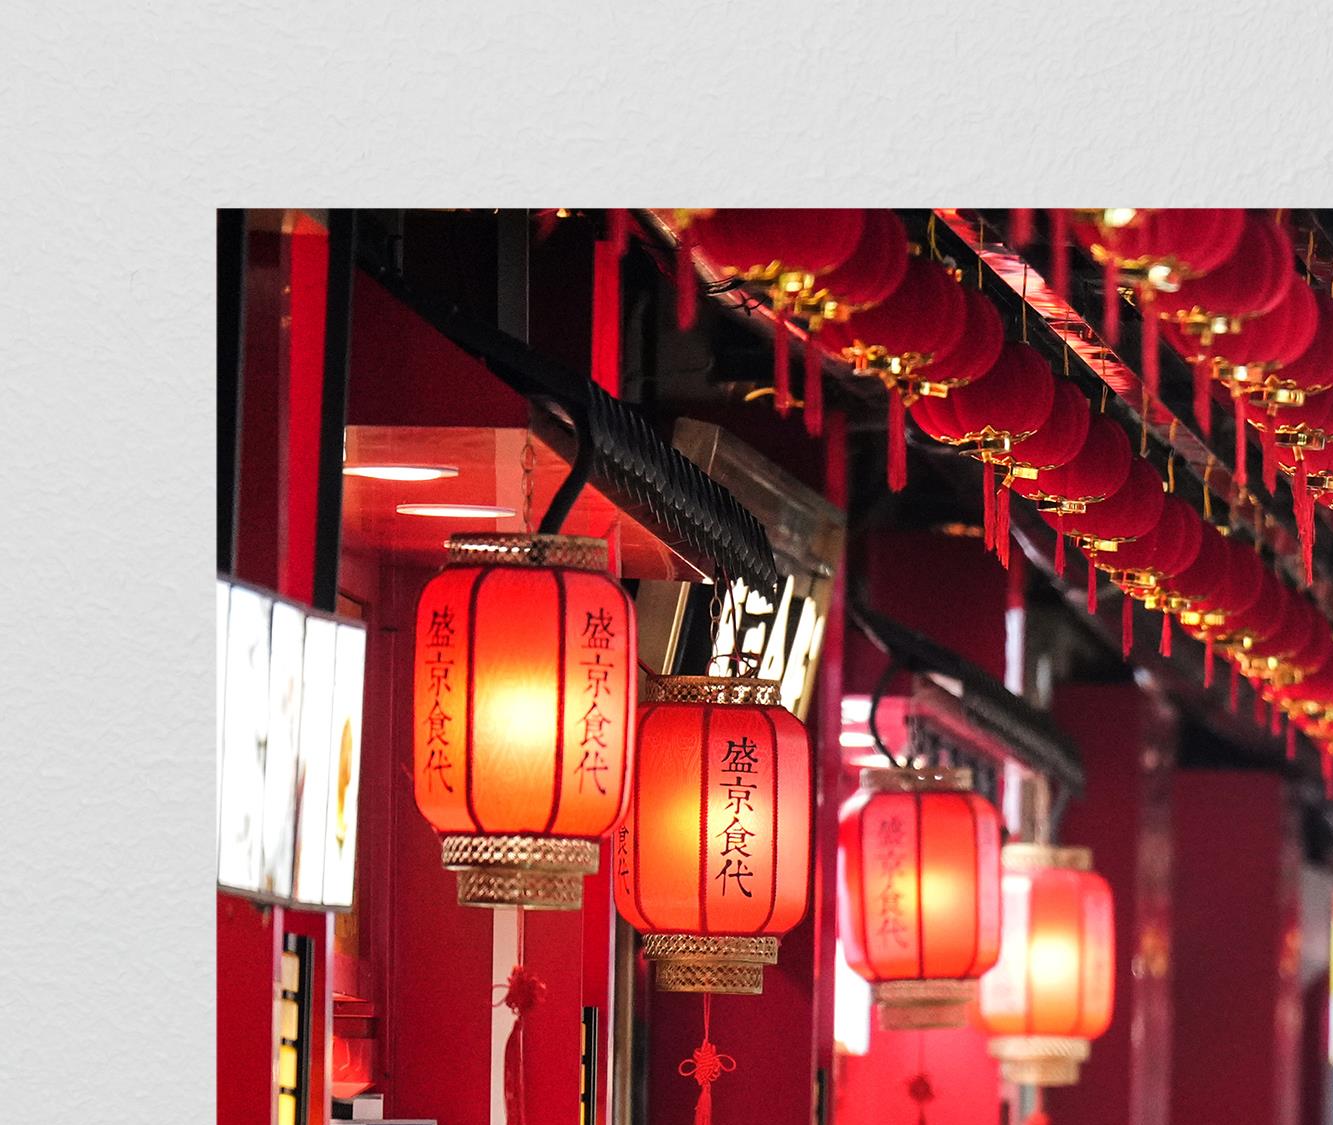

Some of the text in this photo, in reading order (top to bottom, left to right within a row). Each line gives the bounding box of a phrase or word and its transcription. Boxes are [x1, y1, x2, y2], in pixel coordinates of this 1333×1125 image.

[422, 605, 455, 793] 盛京食代
[574, 608, 615, 796] 盛京食代
[714, 736, 759, 898] 盛京食代
